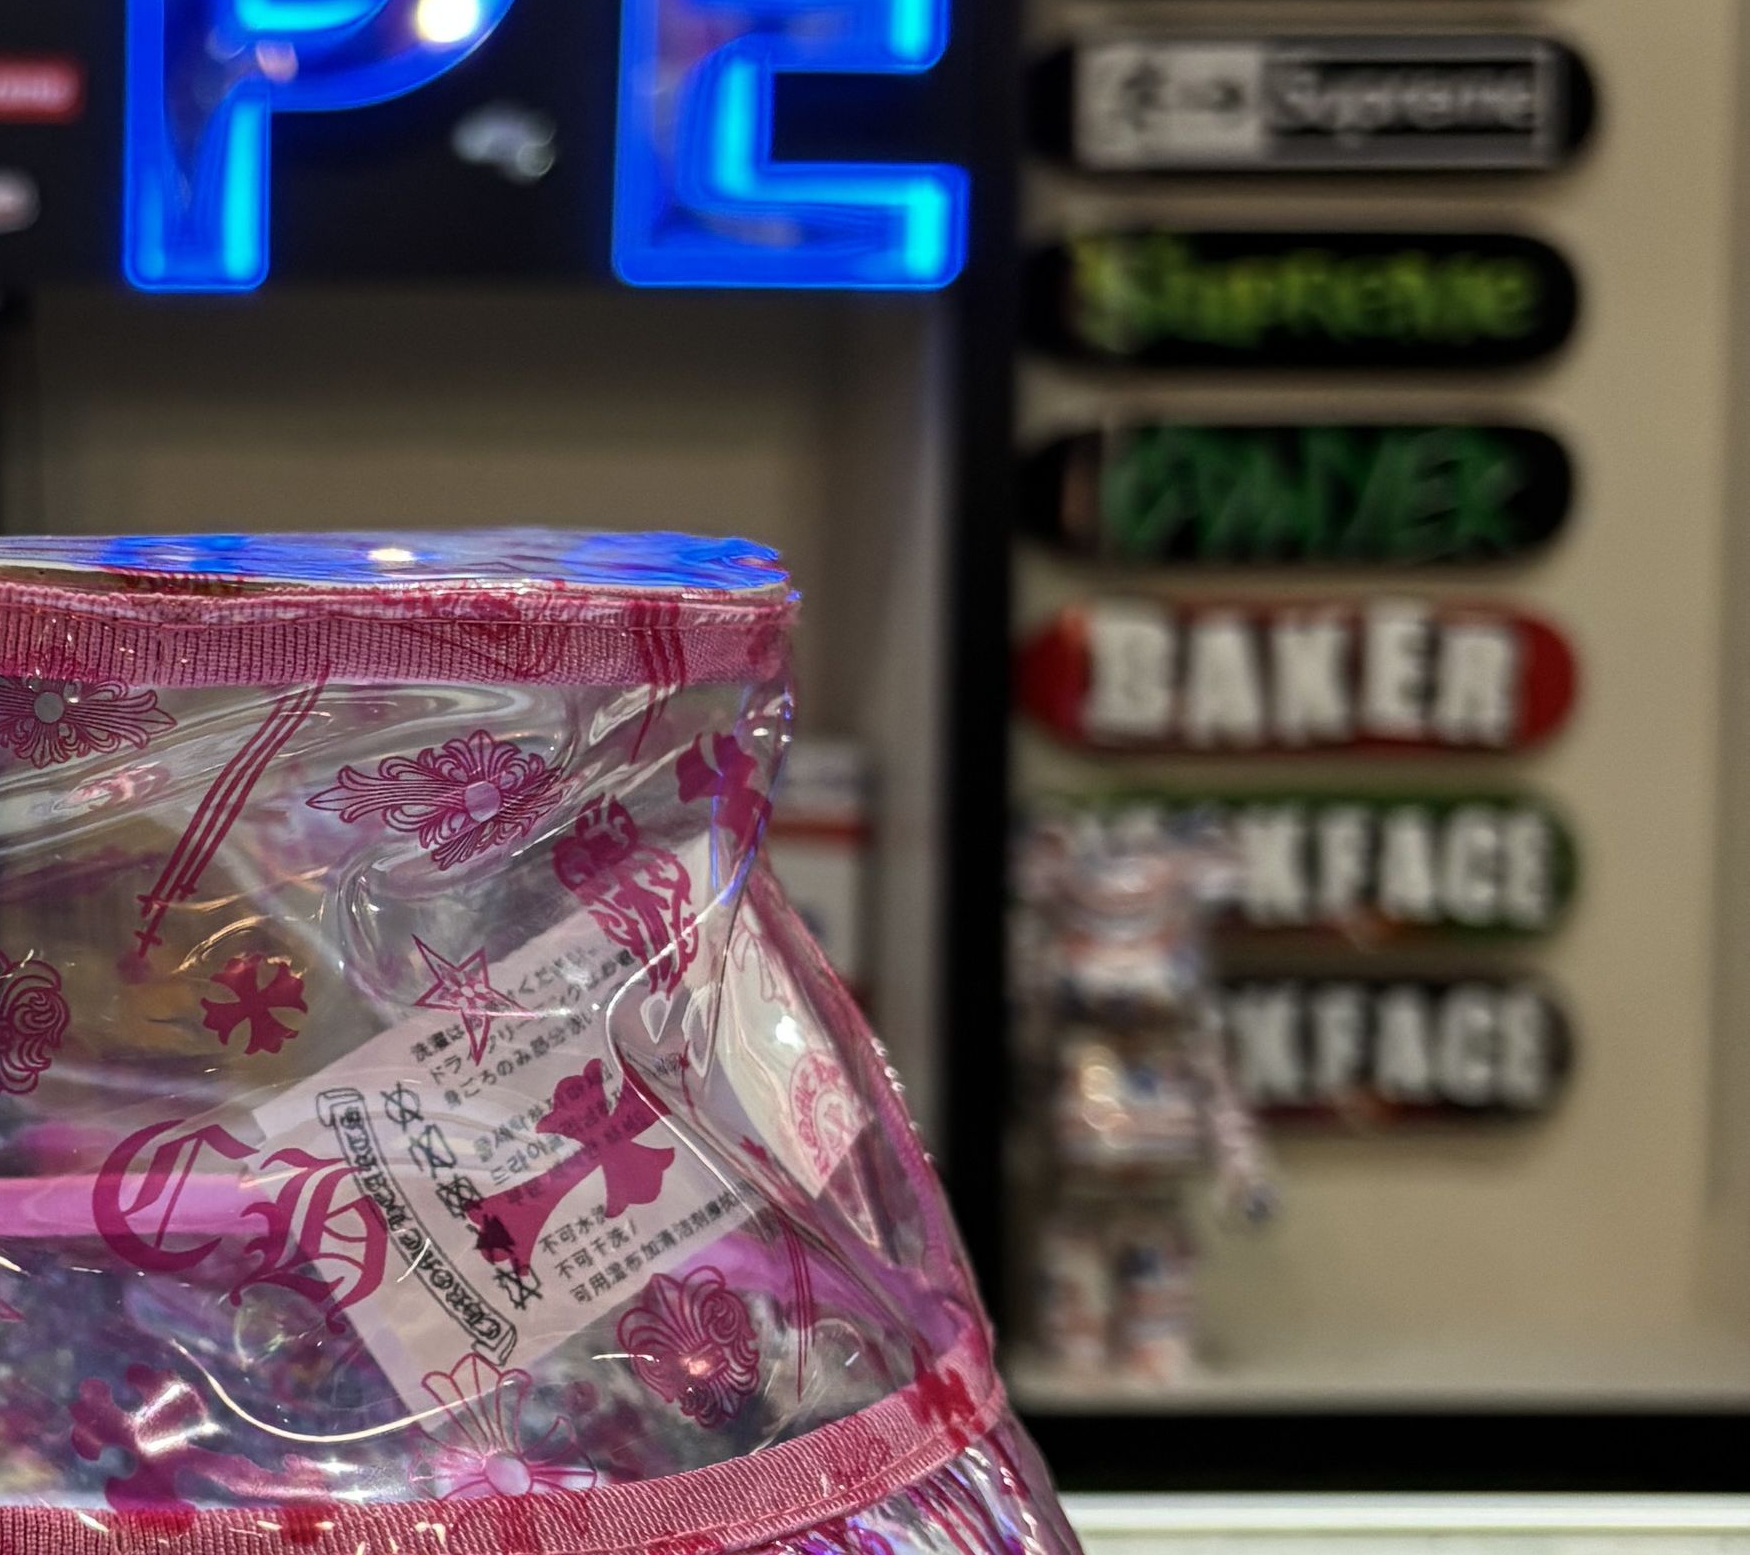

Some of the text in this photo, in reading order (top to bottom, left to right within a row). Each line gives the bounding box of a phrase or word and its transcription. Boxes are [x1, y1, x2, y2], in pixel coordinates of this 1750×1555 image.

[1279, 68, 1534, 148] Supreme
[1083, 598, 1517, 747] BAKER
[400, 1228, 502, 1342] CHROME
